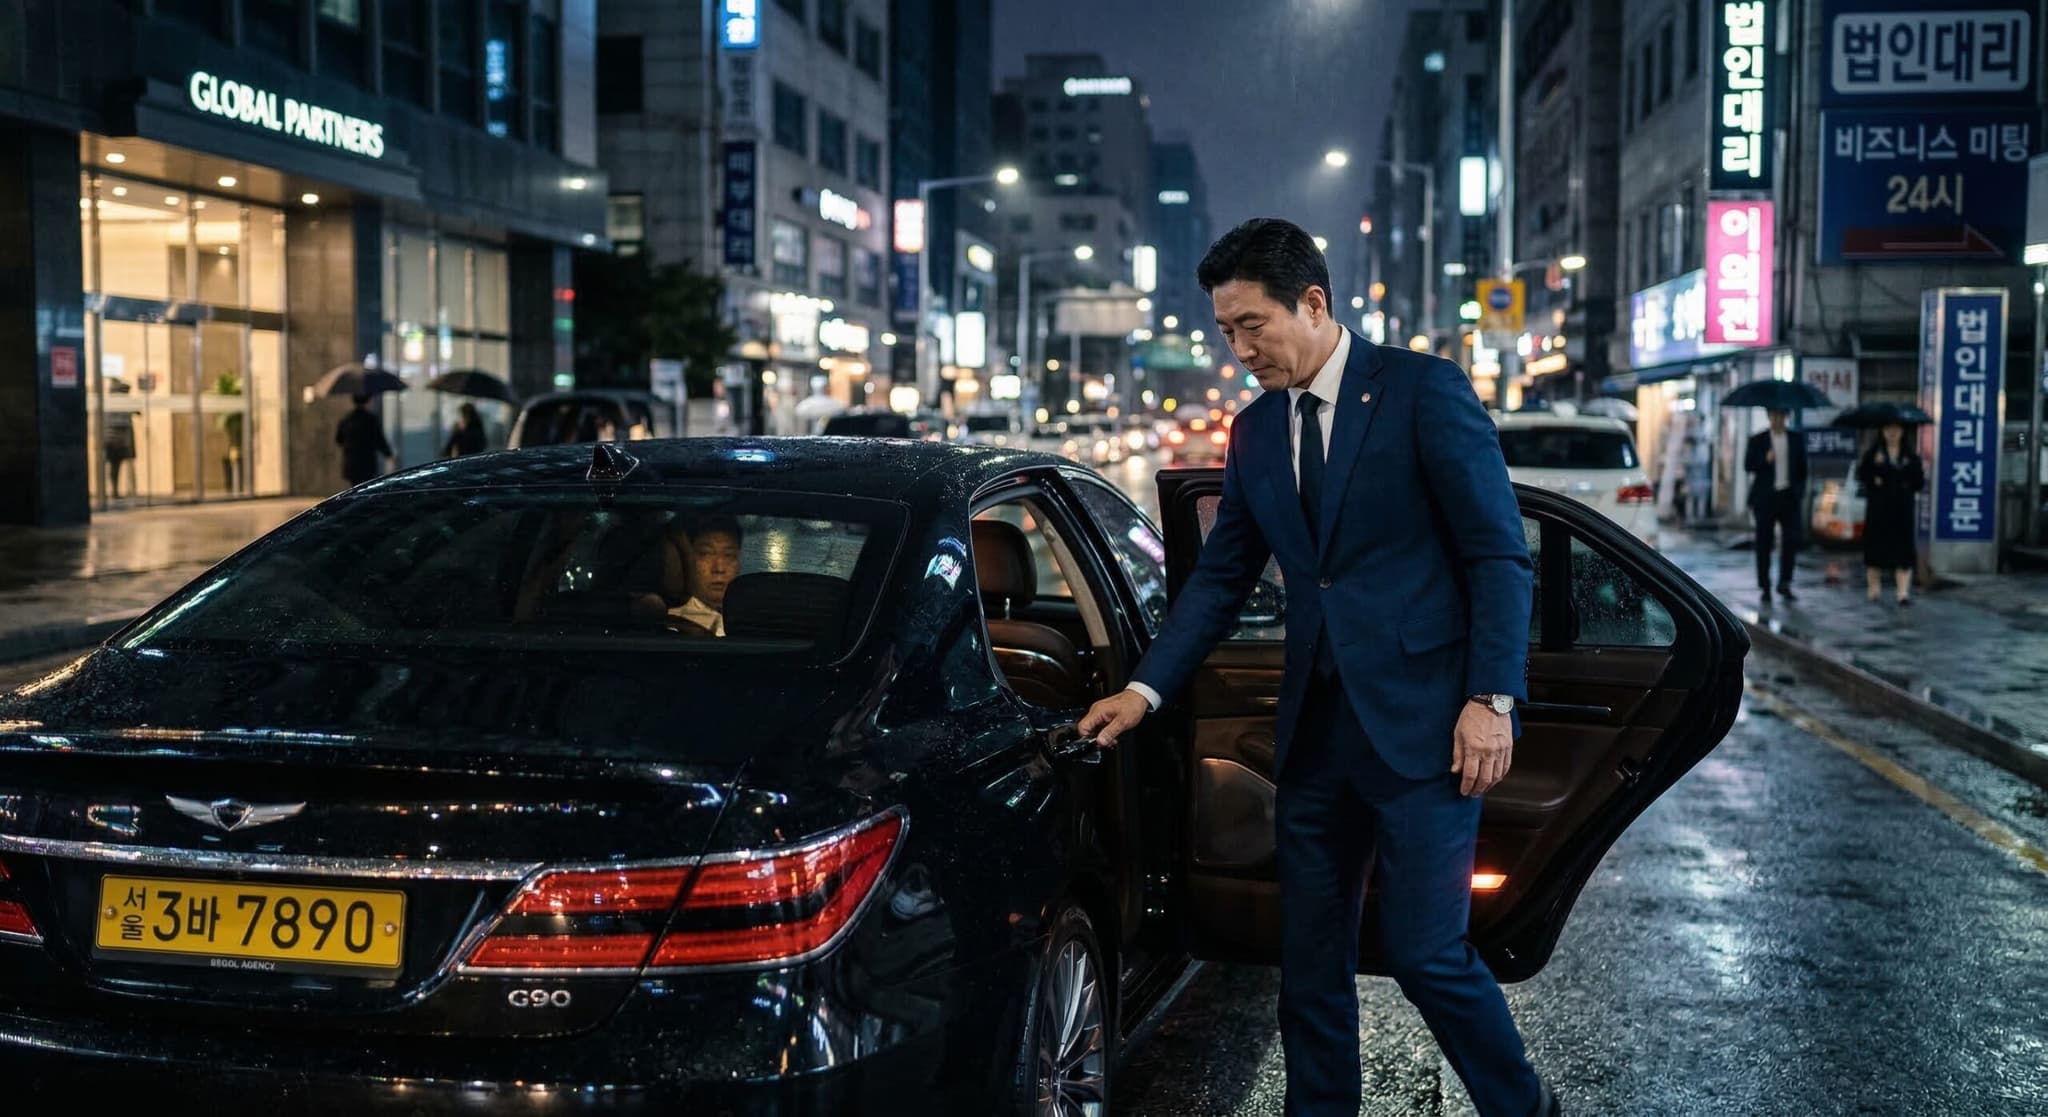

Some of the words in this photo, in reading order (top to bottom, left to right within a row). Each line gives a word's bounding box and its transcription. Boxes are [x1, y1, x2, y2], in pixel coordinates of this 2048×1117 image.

[1842, 19, 2021, 83] 법인대리
[190, 71, 283, 131] GLOBAL
[284, 98, 384, 159] PARTNERS
[1722, 1, 1765, 178] 법인대리
[1835, 123, 1958, 162] 비즈니스
[1968, 123, 2029, 162] 미팅
[1886, 172, 1964, 215] 24시
[1954, 308, 1988, 454] 법인대리
[1950, 460, 1984, 532] 전문
[120, 886, 147, 942] 서울
[153, 890, 221, 943] 3바
[237, 894, 375, 953] 7890
[508, 989, 571, 1007] G90
